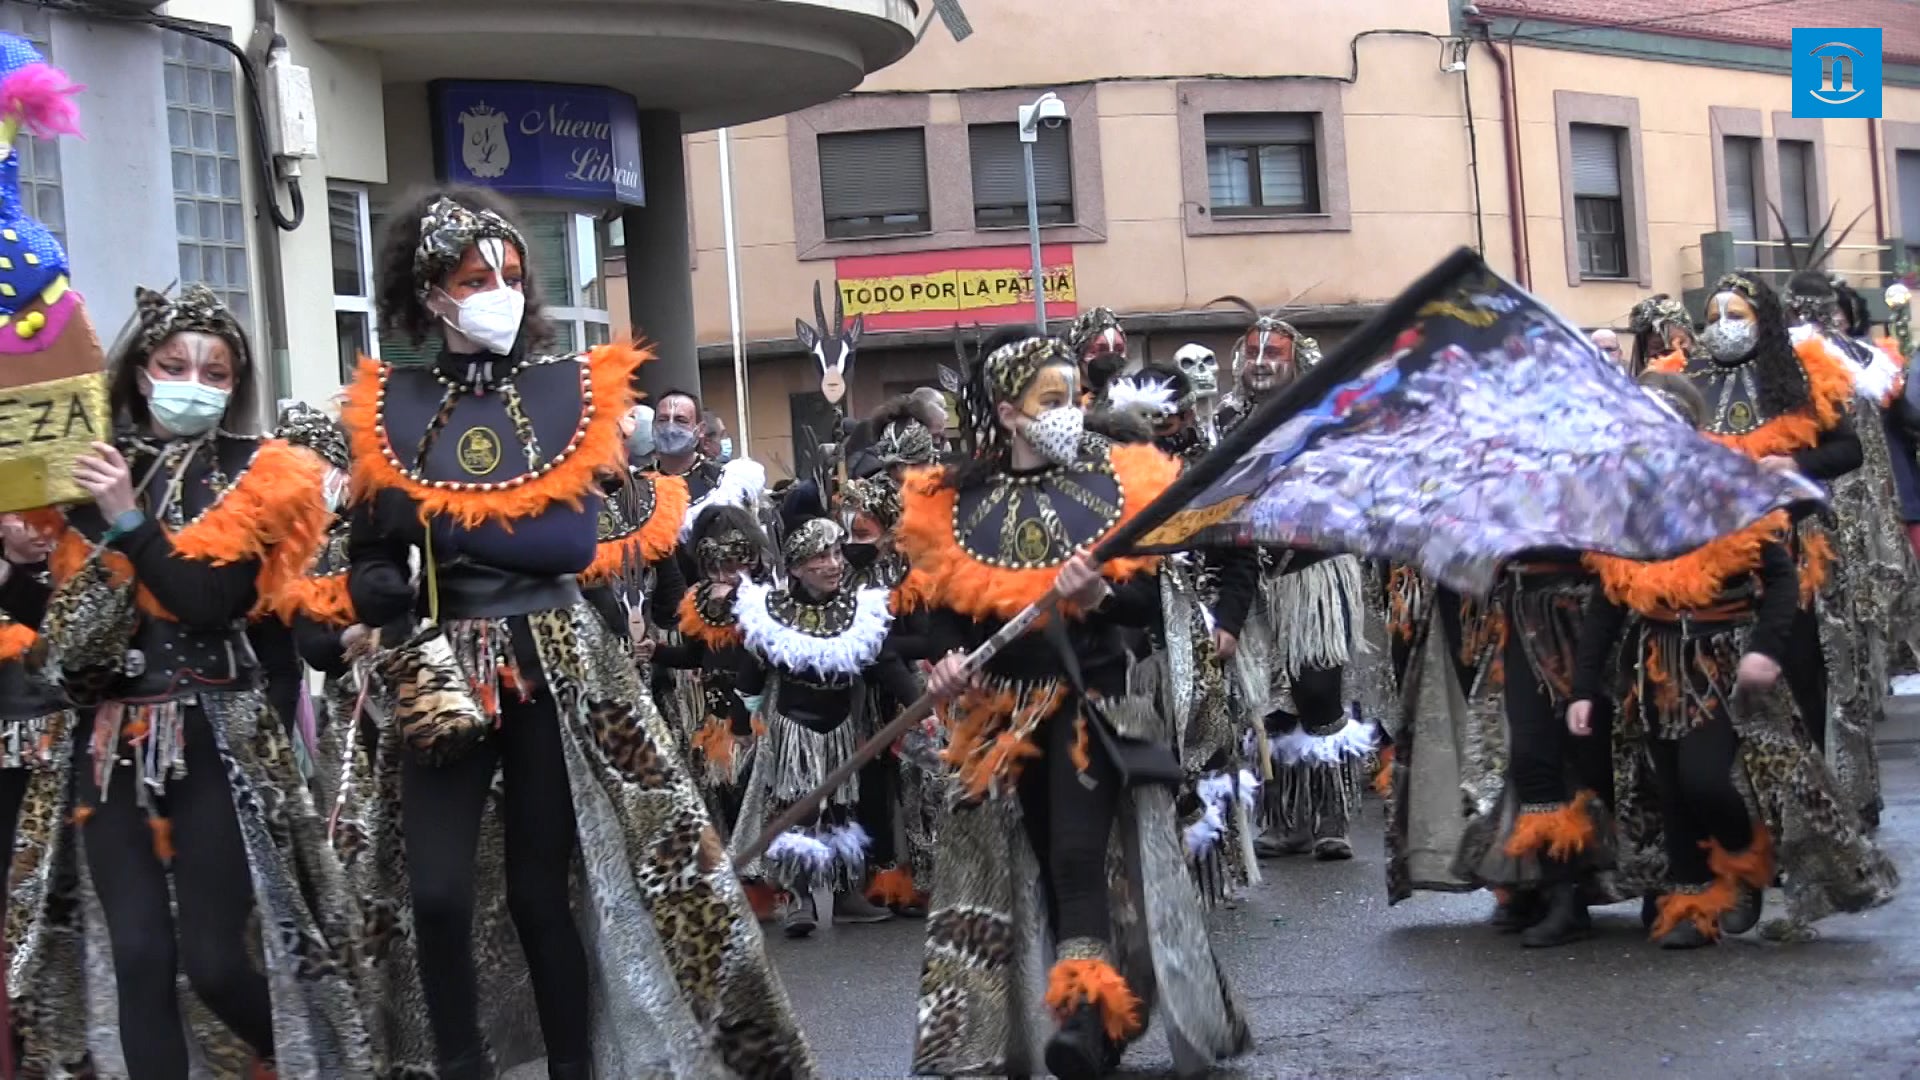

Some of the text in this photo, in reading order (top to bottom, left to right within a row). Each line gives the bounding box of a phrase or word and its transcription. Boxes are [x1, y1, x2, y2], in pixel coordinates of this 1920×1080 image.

[520, 102, 609, 140] Nueva
[843, 285, 905, 304] TODO
[911, 282, 957, 300] POR
[963, 279, 990, 296] LA
